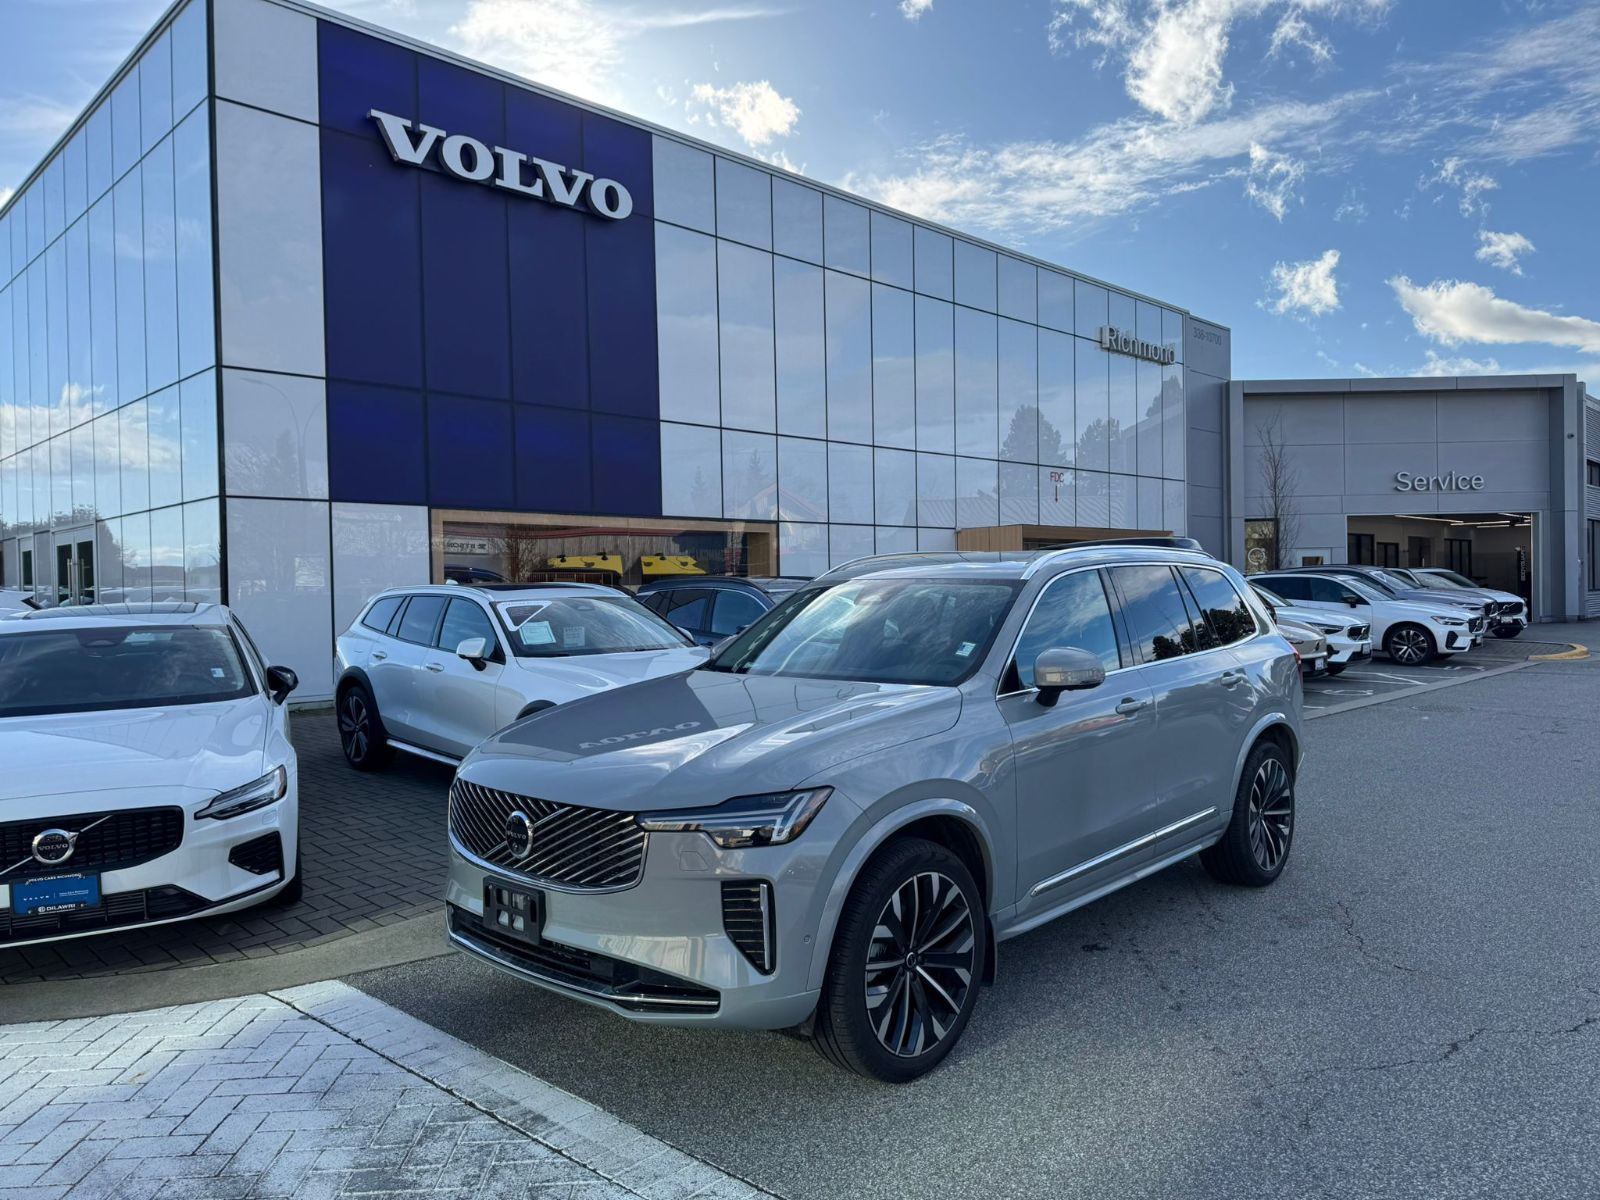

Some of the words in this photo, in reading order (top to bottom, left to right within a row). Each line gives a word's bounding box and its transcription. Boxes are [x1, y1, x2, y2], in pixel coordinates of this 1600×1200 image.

[368, 108, 633, 220] VOLVO
[1099, 326, 1176, 364] Richmond
[1395, 470, 1484, 491] Service
[38, 843, 69, 851] VOLVO
[46, 903, 76, 912] DILAWRI
